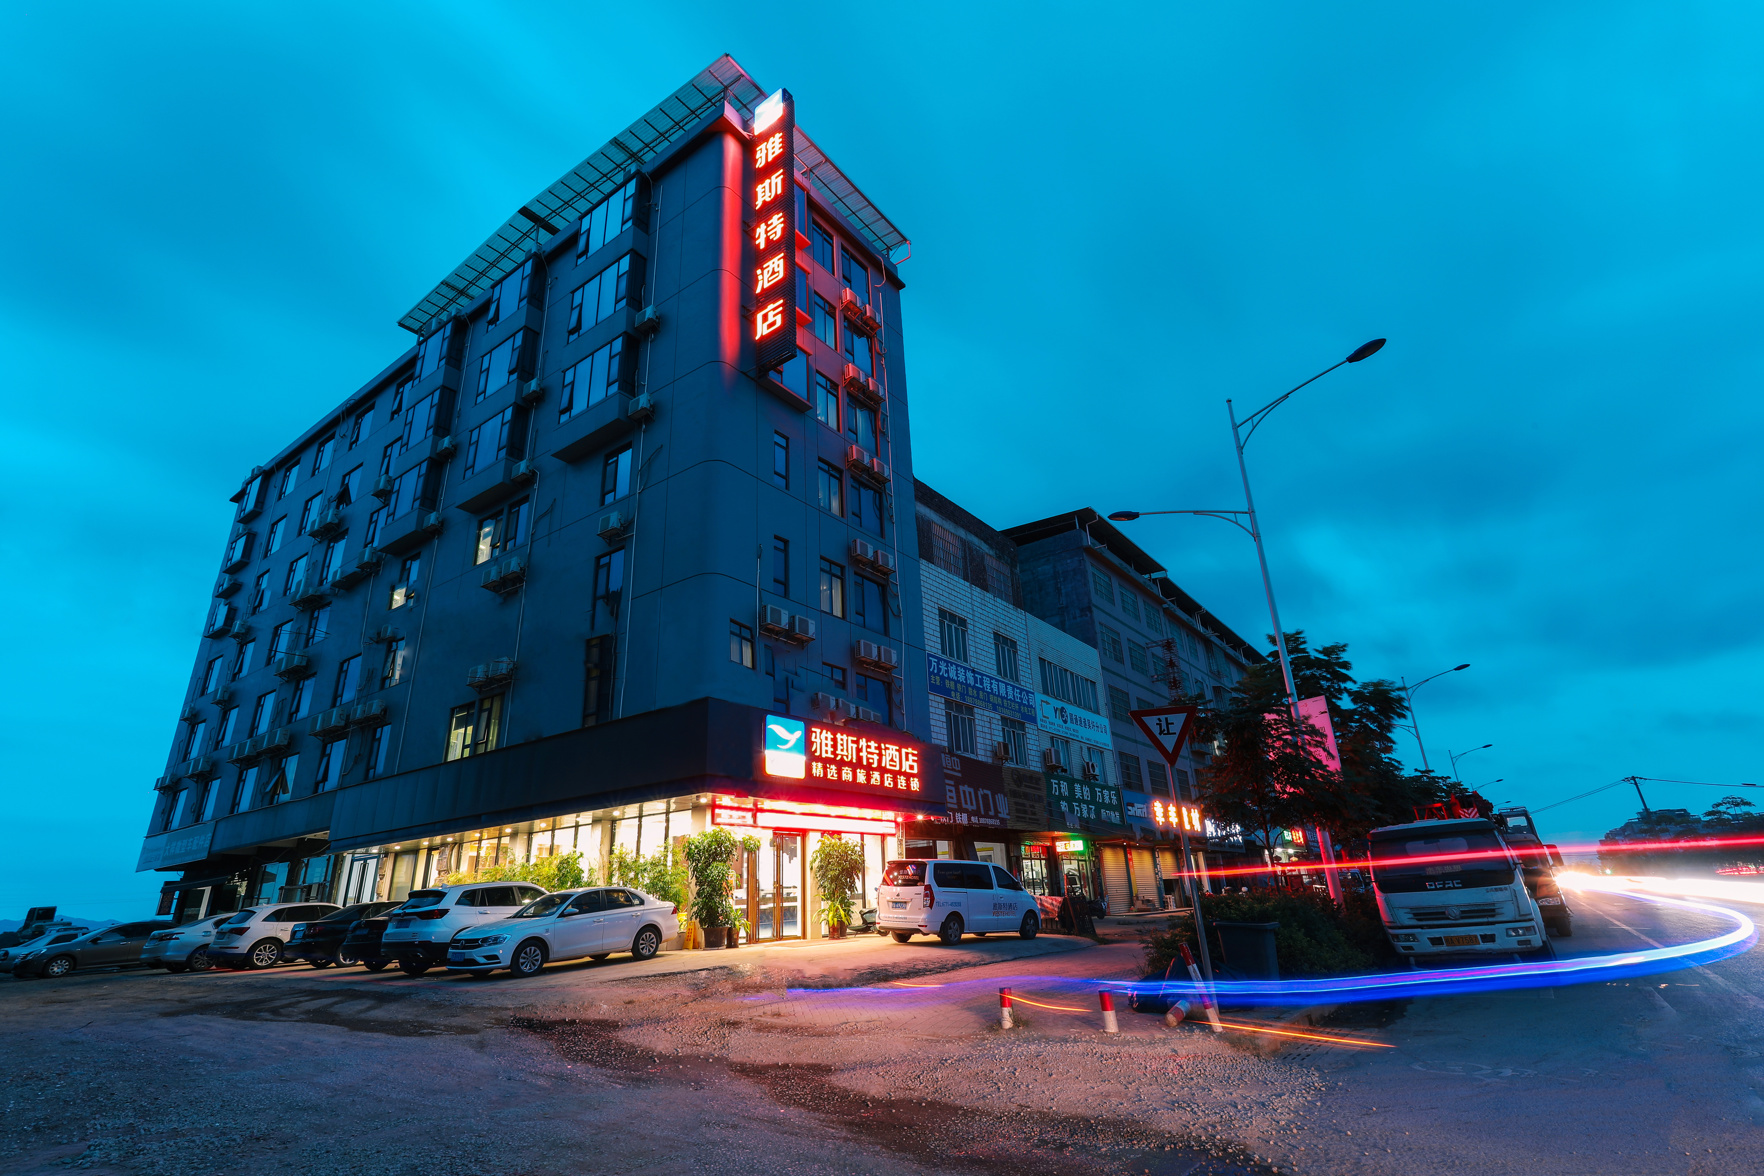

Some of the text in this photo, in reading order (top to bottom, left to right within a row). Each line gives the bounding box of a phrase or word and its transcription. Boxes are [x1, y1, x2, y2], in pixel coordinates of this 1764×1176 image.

[755, 132, 784, 340] 雅斯特酒店
[1156, 717, 1176, 736] 让
[811, 727, 918, 775] 雅斯特酒店
[811, 761, 920, 792] 精选商旅酒店连锁
[1051, 779, 1068, 796] 万和
[1074, 783, 1091, 800] 美的
[1095, 788, 1118, 805] 万家乐
